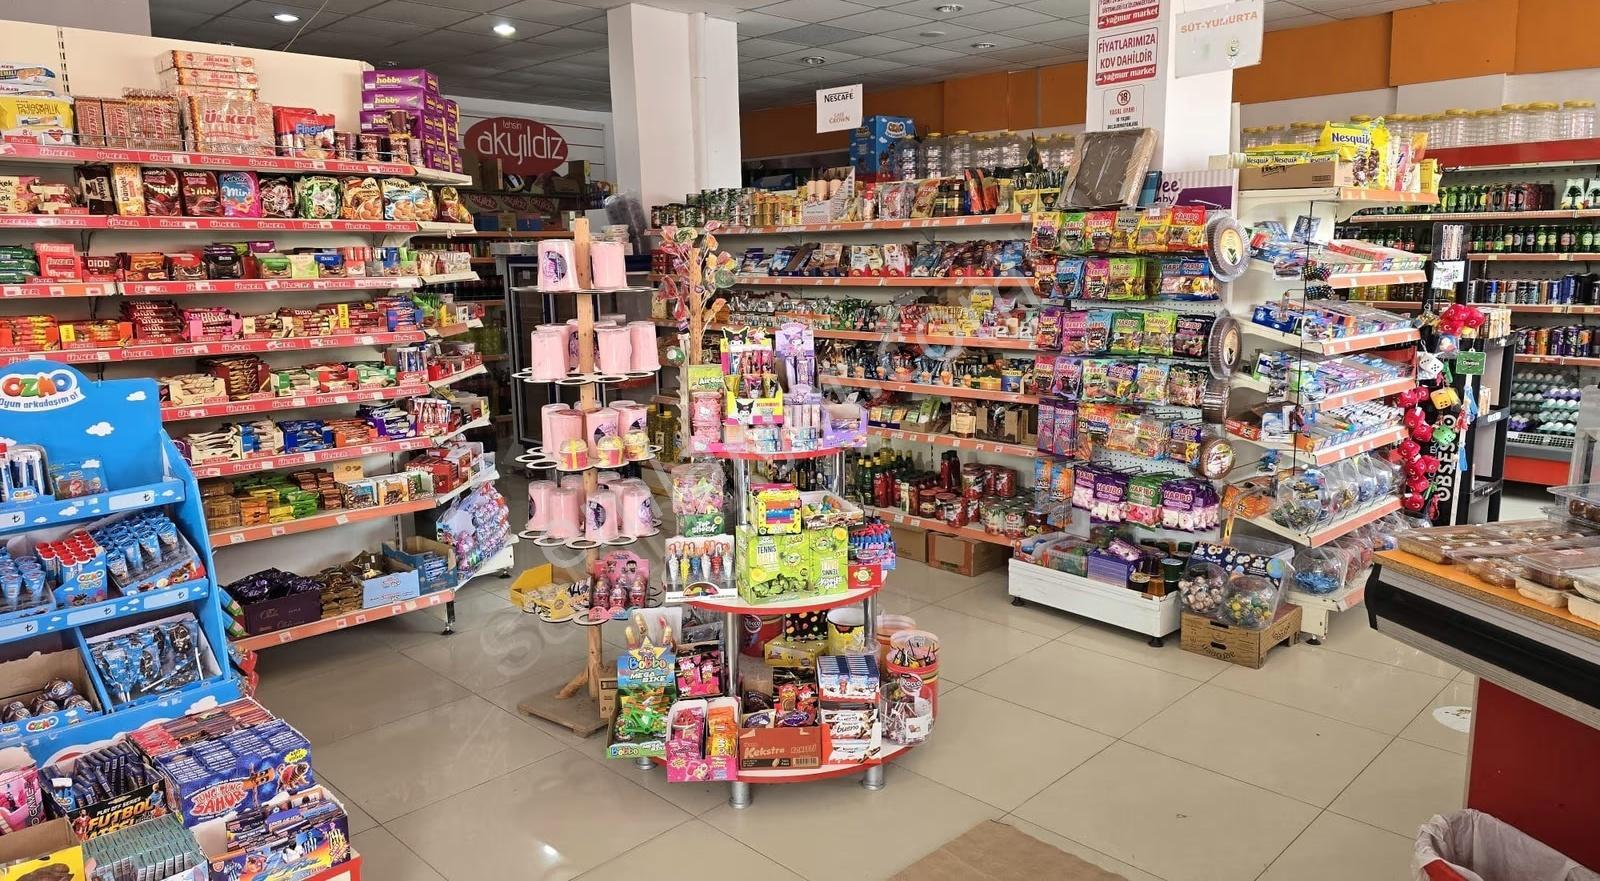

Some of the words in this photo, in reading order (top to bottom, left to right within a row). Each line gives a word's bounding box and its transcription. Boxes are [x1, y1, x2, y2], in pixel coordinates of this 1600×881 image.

[1105, 13, 1131, 25] yağmur
[1132, 7, 1158, 19] market
[1098, 33, 1156, 54] FİYATLARIMIZA
[1100, 55, 1116, 69] KDV
[1117, 51, 1152, 67] DAHİLDİR
[1103, 70, 1130, 82] yağmur
[1130, 67, 1156, 79] market
[376, 76, 401, 86] hobby
[375, 95, 401, 105] hobby
[204, 109, 258, 132] ÜLKER
[295, 122, 326, 136] Finger
[477, 122, 564, 166] akyıldız
[1331, 132, 1371, 145] Nesquik
[1246, 157, 1269, 165] Nesquik
[1274, 156, 1297, 164] Nesquik
[183, 170, 208, 178] Dankek
[119, 175, 130, 202] Dankek
[383, 180, 410, 190] Dankek
[1118, 217, 1139, 225] HARIBO
[0, 398, 21, 409] Oyun
[23, 397, 70, 409] arkadaşım
[1437, 414, 1457, 502] OBSESO
[405, 464, 433, 472] tadelle
[1076, 470, 1094, 480] HARIB
[1096, 483, 1123, 496] HARIBO
[1164, 490, 1192, 502] HARIBO
[757, 545, 776, 554] TENNIS
[628, 656, 667, 670] Bobbo
[630, 671, 655, 680] MEGA
[642, 675, 667, 683] BIKE
[836, 724, 860, 733] bueno
[611, 746, 639, 756] Bobbo
[744, 747, 785, 759] Kekstra
[192, 790, 245, 815] SAHUR
[88, 798, 154, 831] FUTBOL
